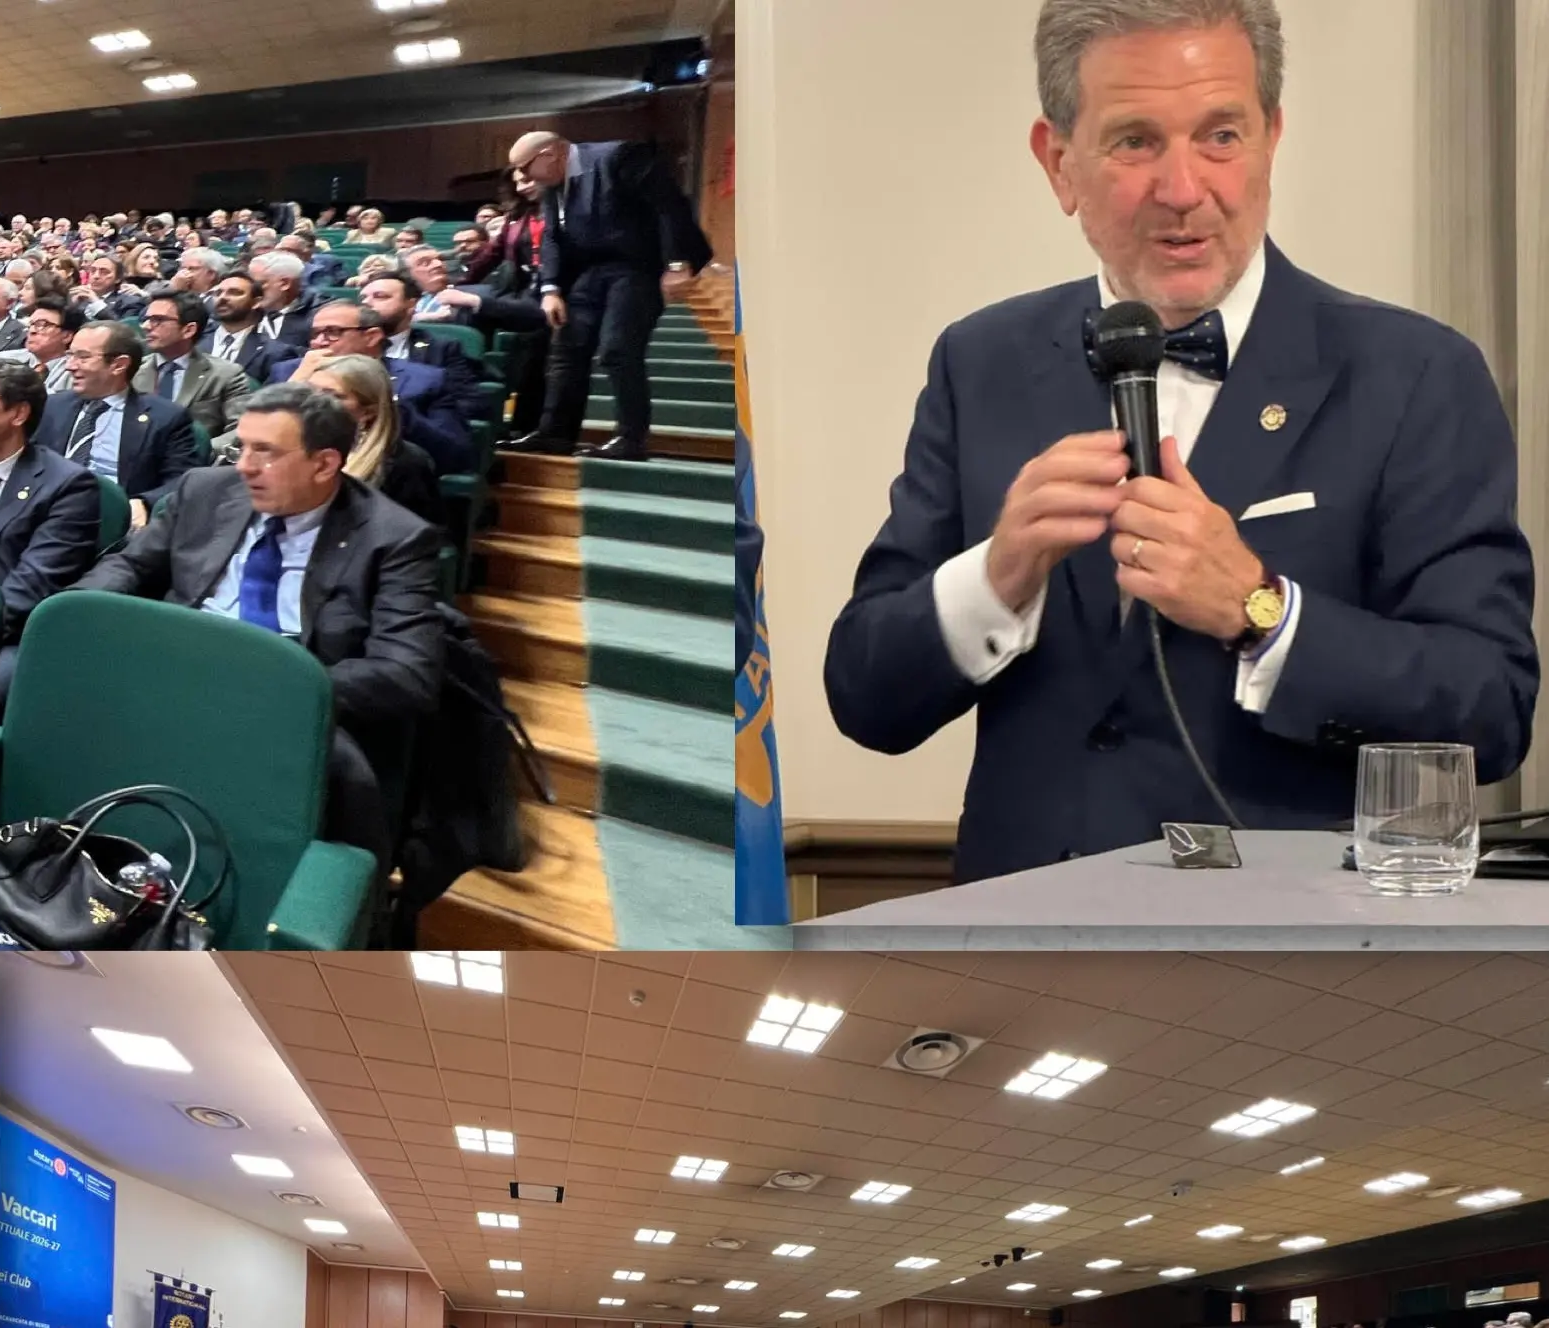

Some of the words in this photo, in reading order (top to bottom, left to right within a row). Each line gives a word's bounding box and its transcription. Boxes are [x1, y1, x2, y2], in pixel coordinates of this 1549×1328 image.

[1, 1192, 57, 1232] Vaccari
[30, 1233, 61, 1251] 2026-27
[9, 1273, 32, 1289] Club
